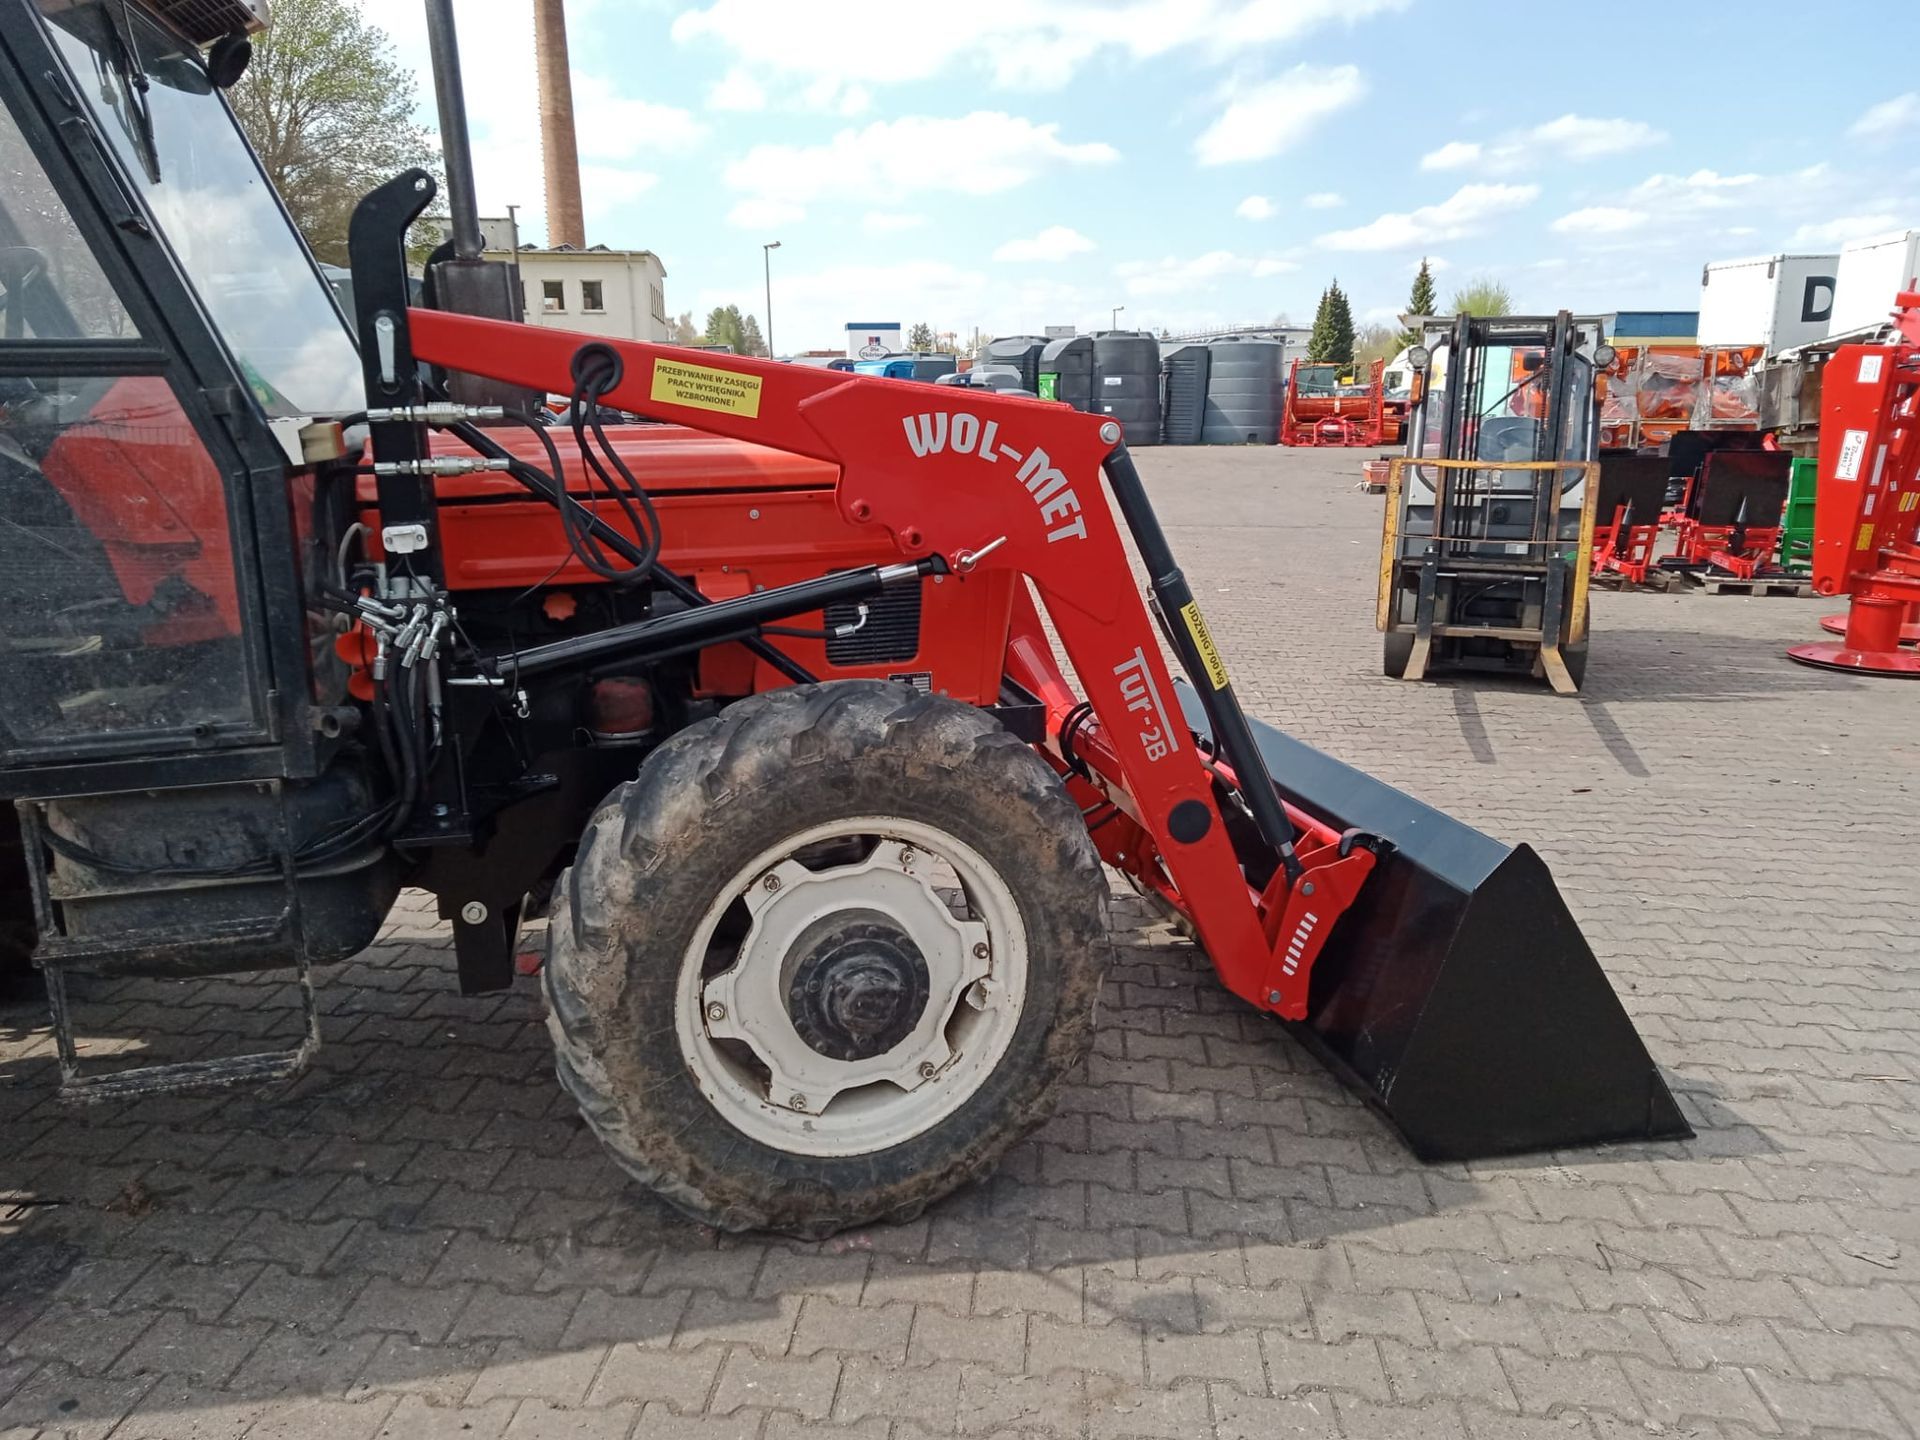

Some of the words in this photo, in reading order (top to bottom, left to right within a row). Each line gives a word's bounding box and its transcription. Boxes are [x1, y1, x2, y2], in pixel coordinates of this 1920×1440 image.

[656, 365, 714, 382] PRZEBYWANIE
[714, 375, 723, 384] W
[724, 377, 760, 390] ZASIĘGU
[667, 377, 694, 391] PRACY
[695, 381, 746, 399] WYSIĘGNIKA
[902, 412, 1087, 543] WOL-MET
[1206, 648, 1220, 669] 700
[1214, 669, 1225, 685] kg
[1113, 646, 1170, 762] Tur-2B
